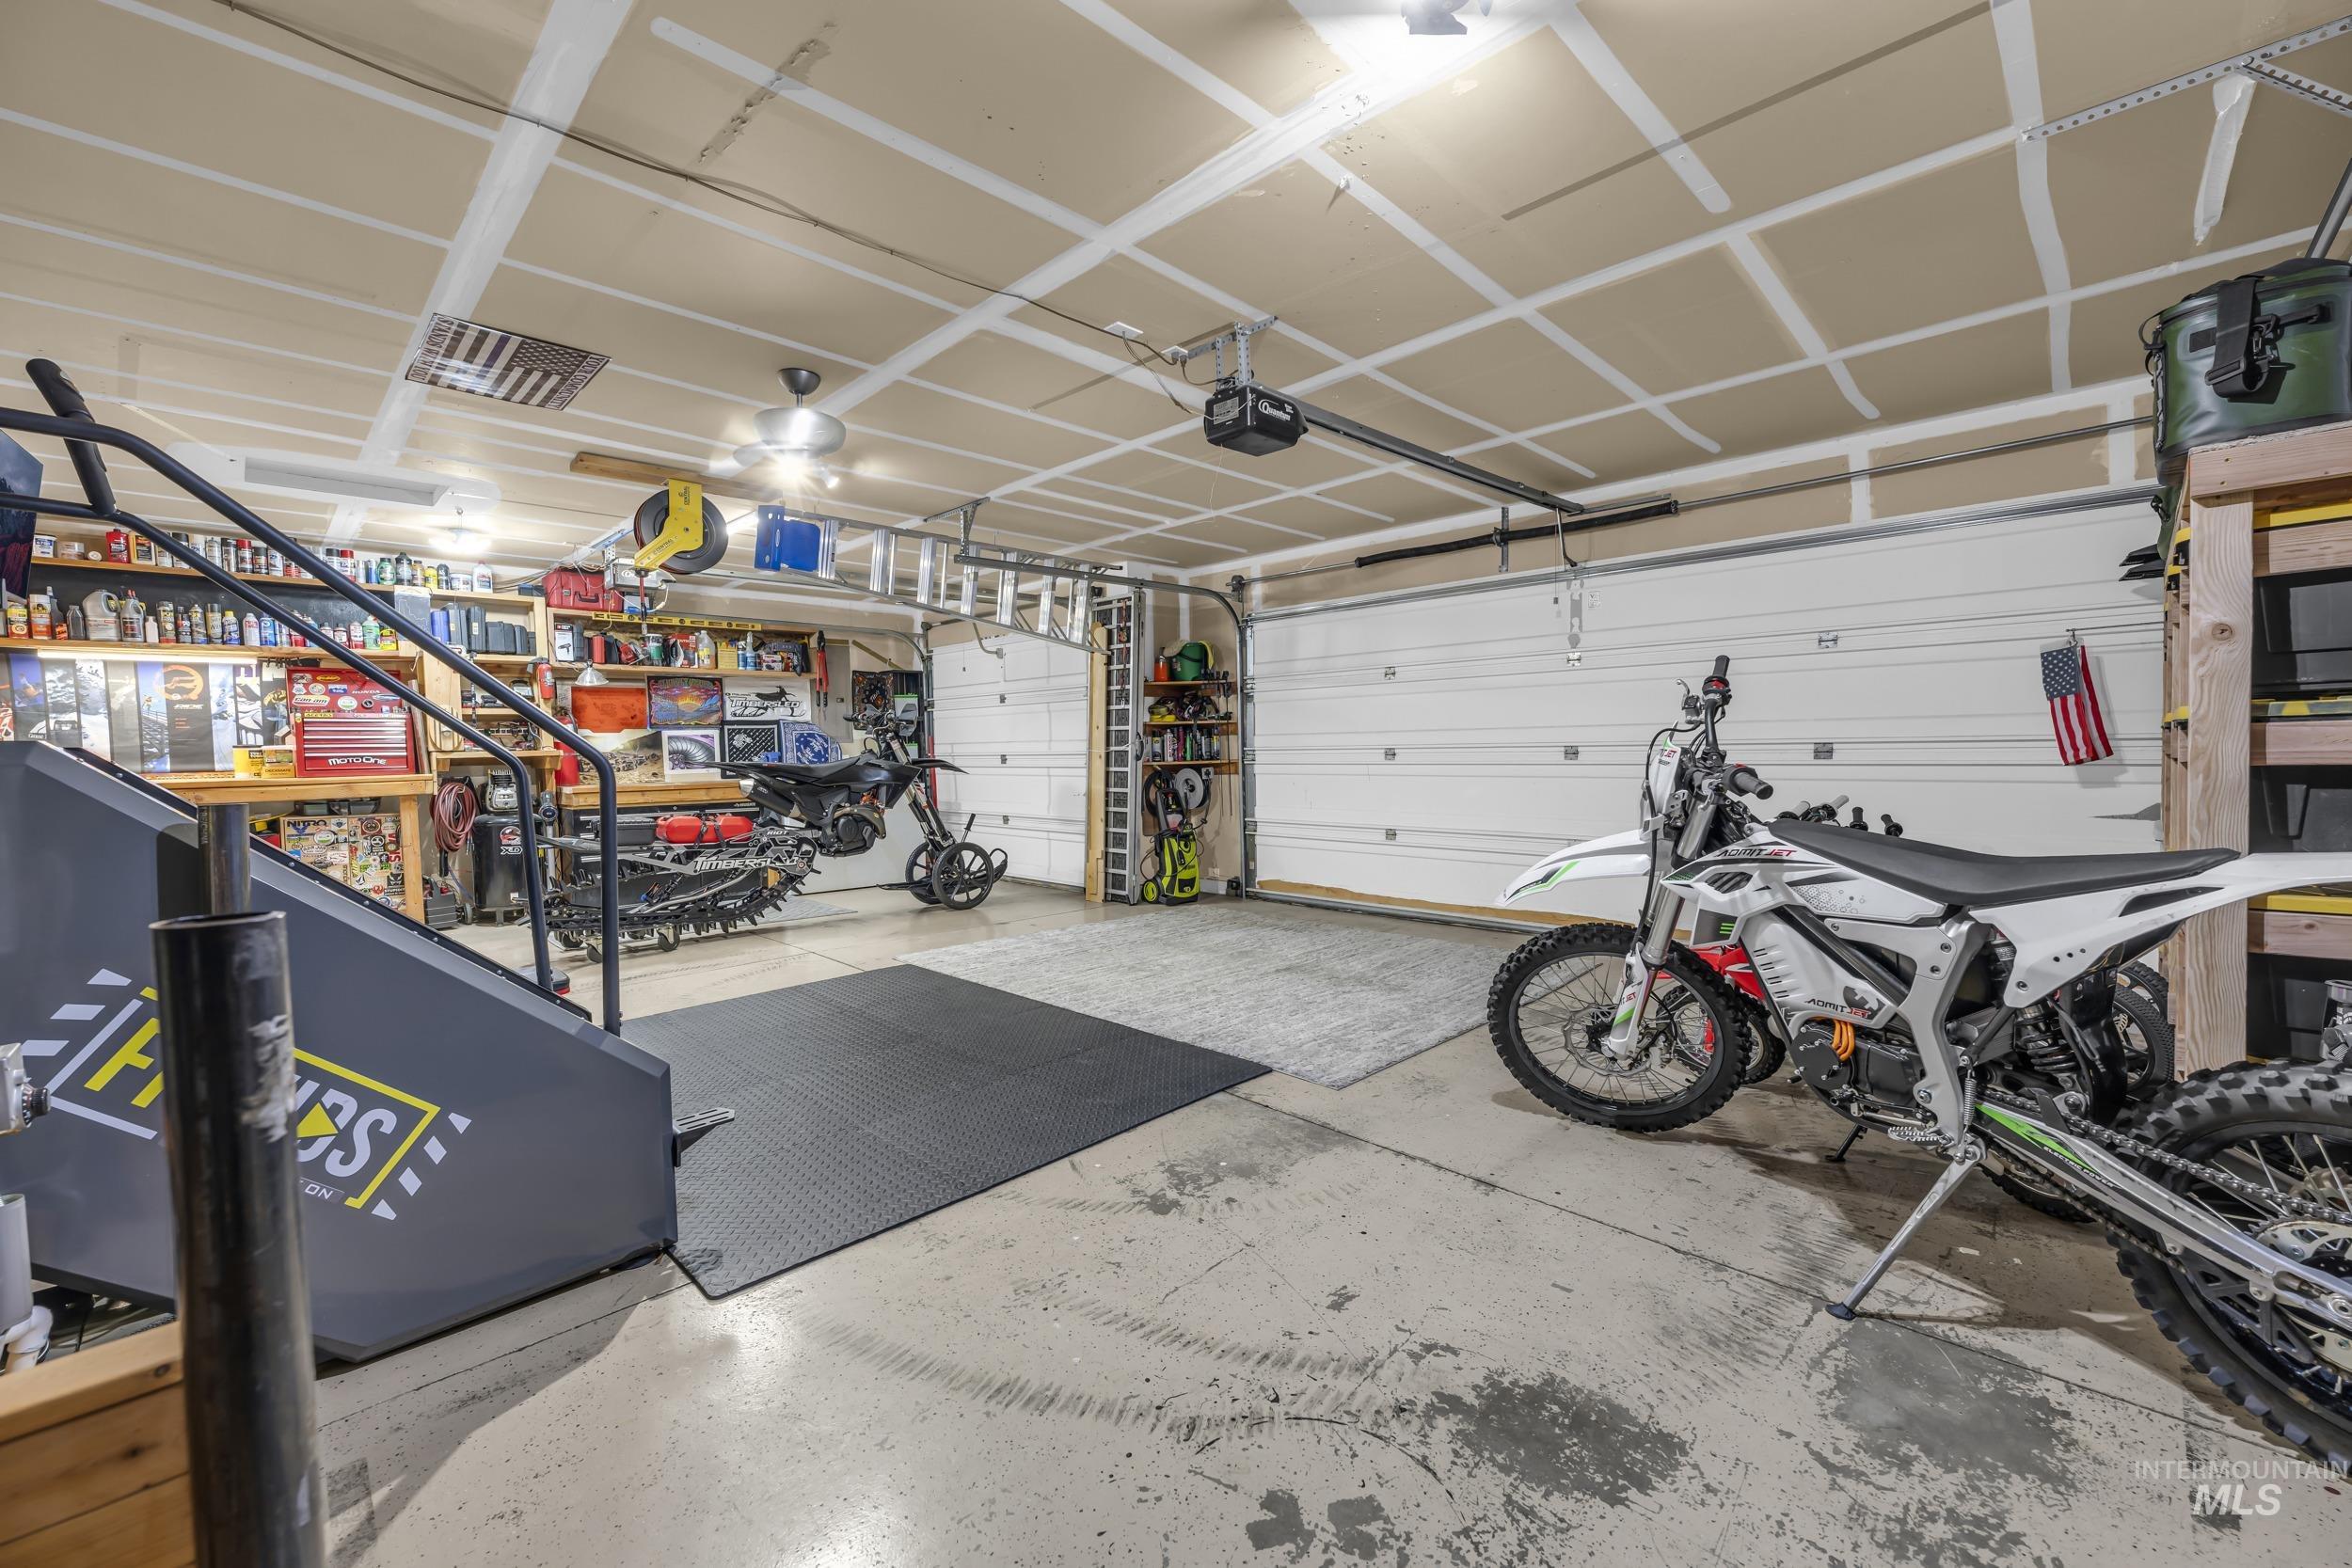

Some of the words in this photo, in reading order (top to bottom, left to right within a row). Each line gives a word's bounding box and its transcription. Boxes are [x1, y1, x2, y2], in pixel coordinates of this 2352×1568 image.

[426, 316, 454, 349] STANDS
[416, 347, 439, 368] WITH
[577, 356, 606, 374] YOUR
[410, 365, 431, 381] YOU
[548, 374, 588, 409] COMMUNITY
[1261, 402, 1291, 421] Quantum
[728, 696, 801, 708] TIMBERSLED
[2043, 1146, 2083, 1171] ELECTRIC
[2083, 1168, 2116, 1187] POWER
